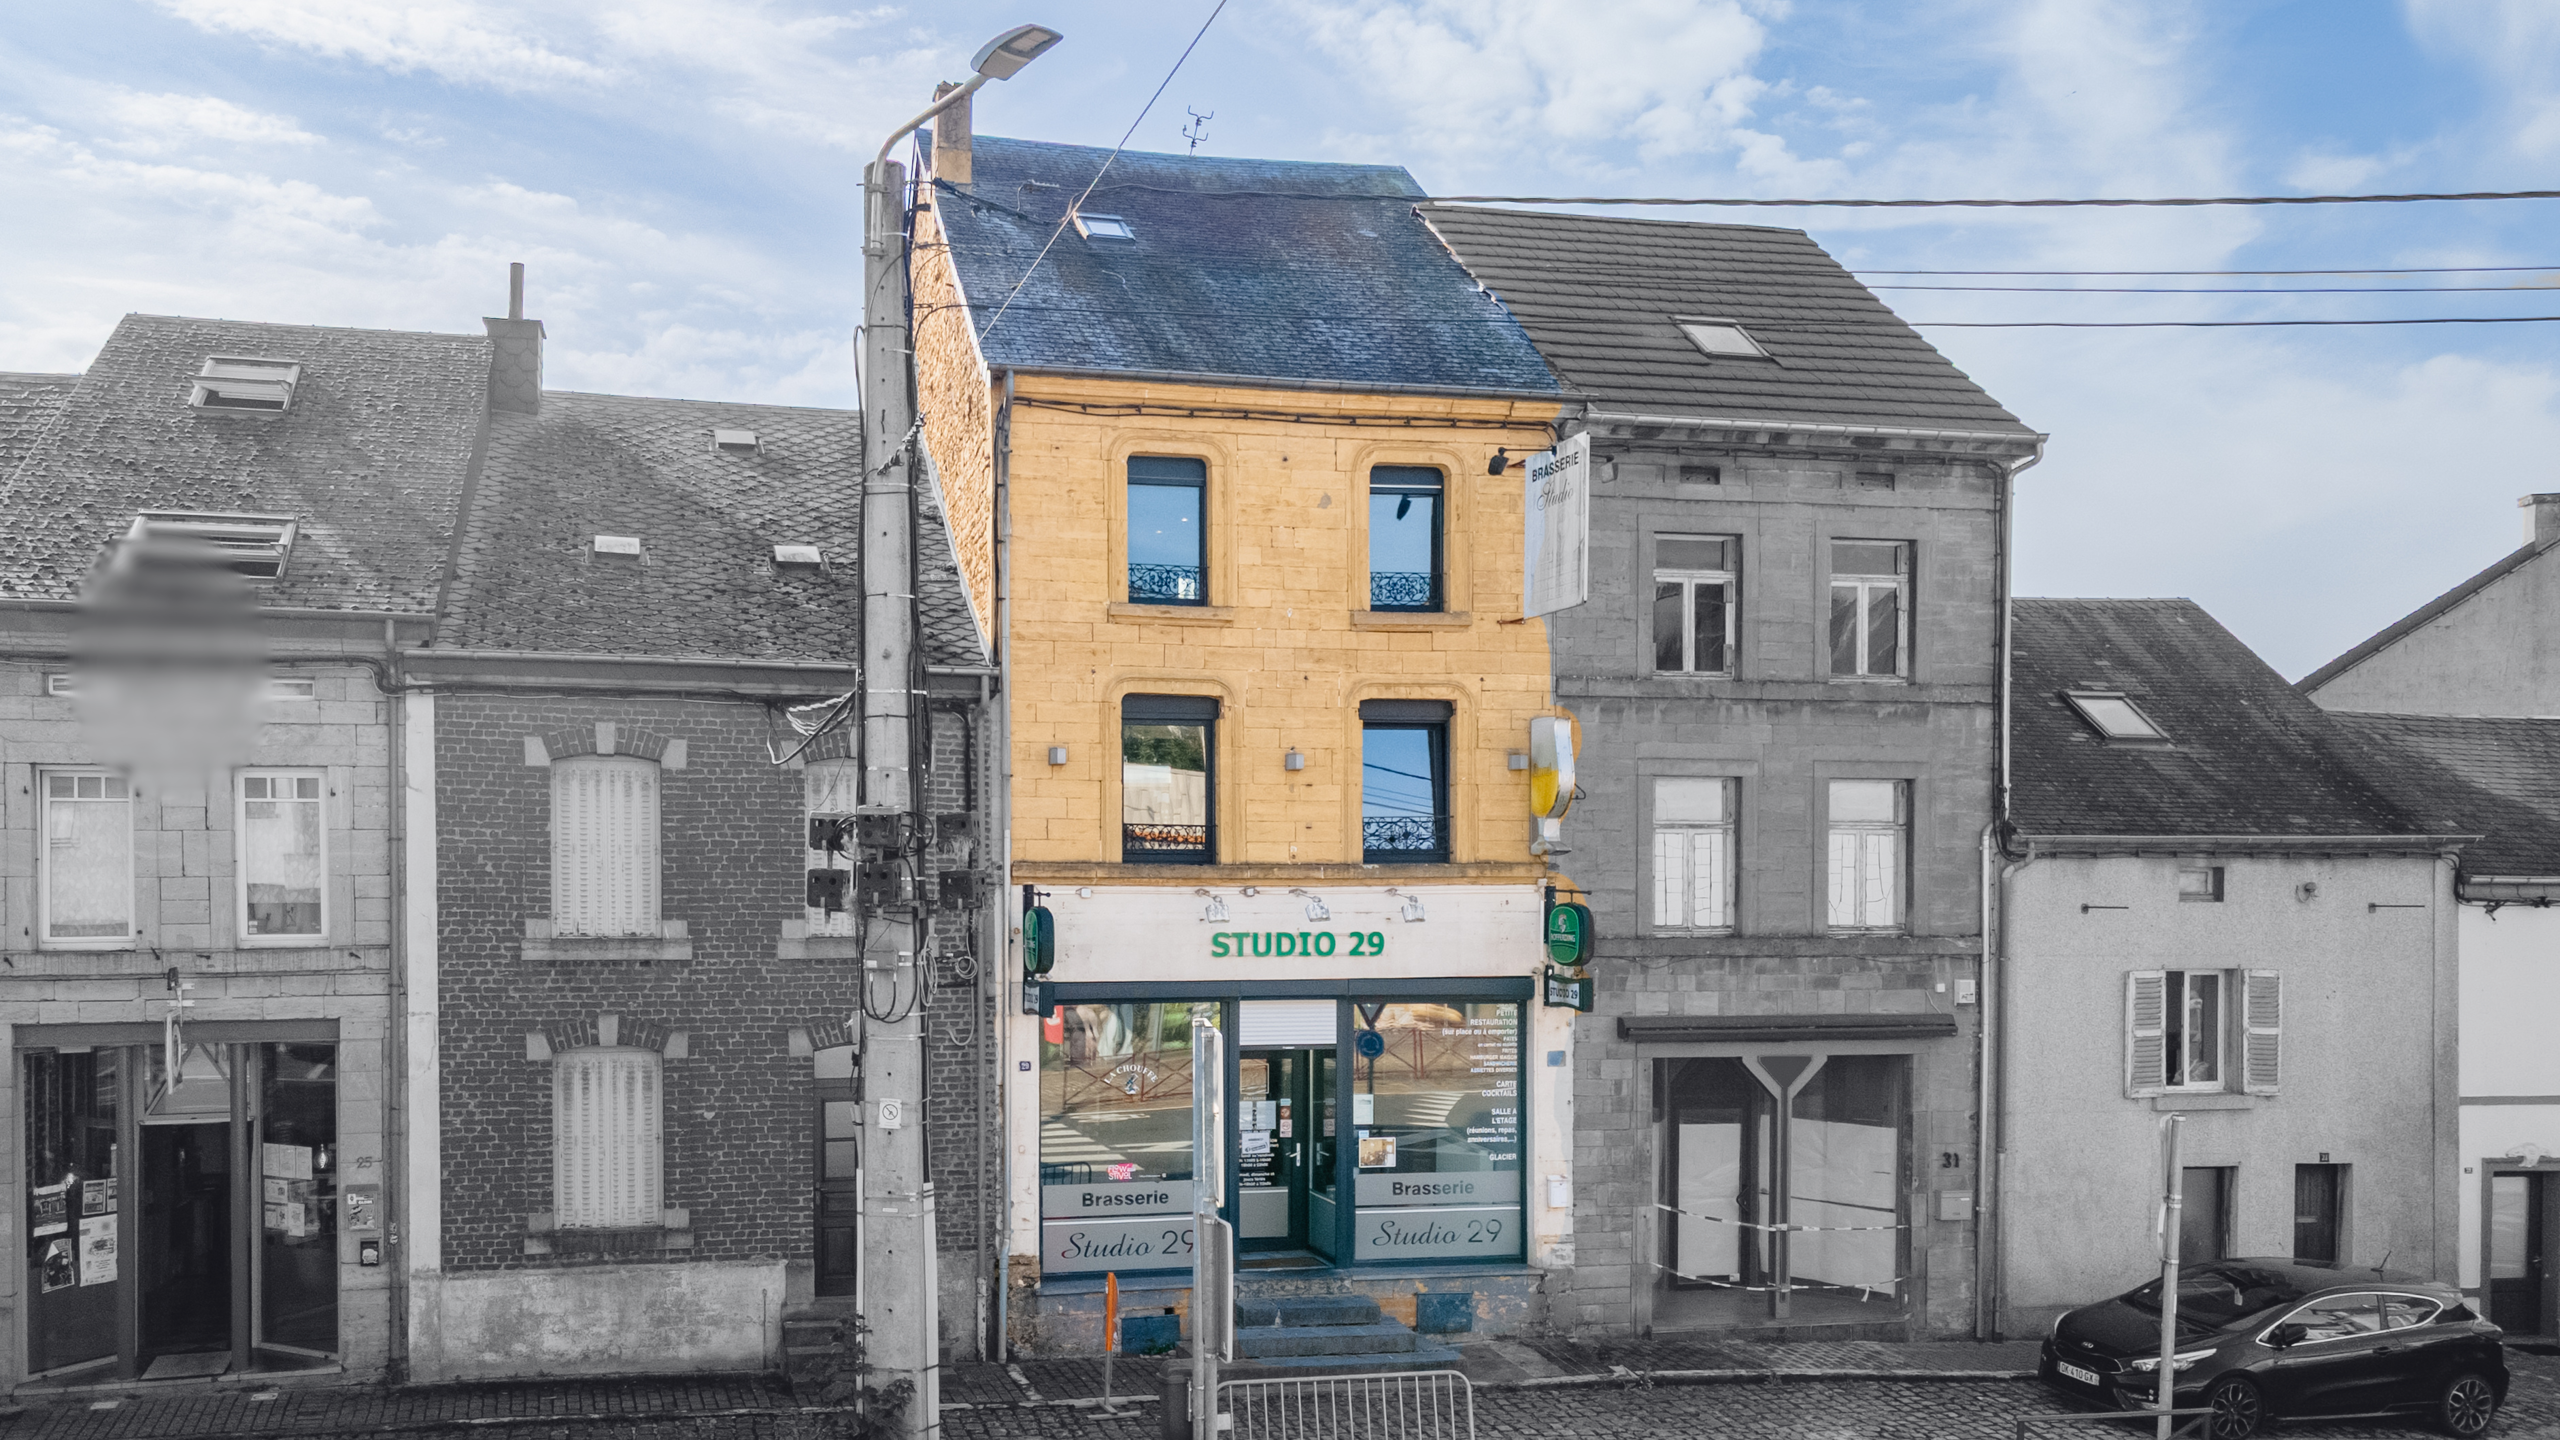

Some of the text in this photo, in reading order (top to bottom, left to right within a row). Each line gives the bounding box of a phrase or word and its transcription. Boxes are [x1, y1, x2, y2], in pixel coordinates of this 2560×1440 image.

[1532, 451, 1579, 483] BRASSERIE
[1537, 478, 1573, 511] Studio
[1211, 931, 1385, 958] STUDIO 29
[1571, 989, 1578, 1000] 29
[1496, 1009, 1518, 1017] PETITE
[1470, 1018, 1518, 1026] RESTAURATION
[1455, 1028, 1472, 1036] place
[1103, 1064, 1159, 1084] LA CHOUFFE
[357, 1156, 373, 1169] 25
[1942, 1152, 1960, 1168] 31
[1392, 1180, 1474, 1196] Brasserie
[1082, 1190, 1169, 1208] Brasserie
[1372, 1218, 1502, 1247] Studio 29
[1061, 1229, 1194, 1259] Studio 29
